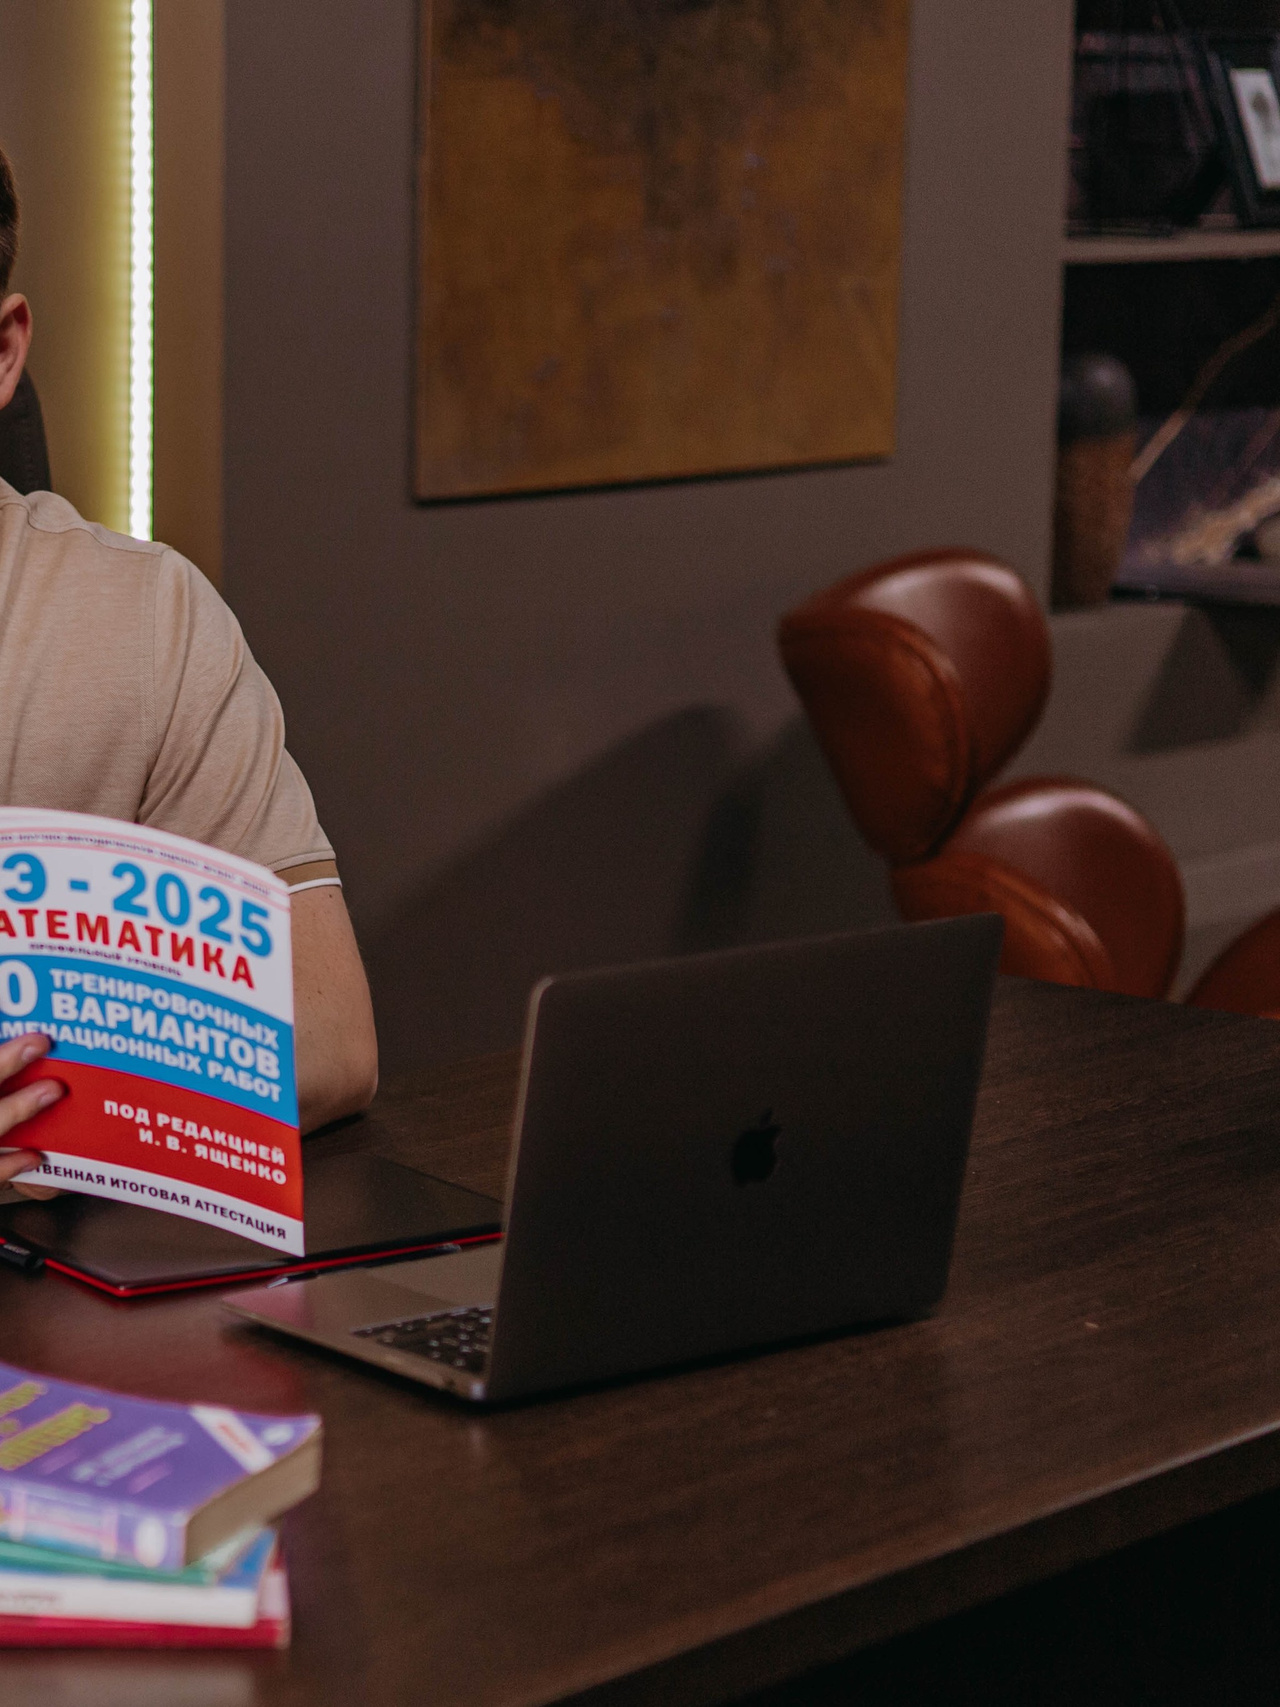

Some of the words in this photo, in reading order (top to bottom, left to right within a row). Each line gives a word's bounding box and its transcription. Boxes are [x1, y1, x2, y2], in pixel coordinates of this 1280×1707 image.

[69, 879, 89, 891] -
[112, 862, 273, 958] 2025
[50, 968, 279, 1050] ТРЕНИРОВОЧНЫХ
[51, 991, 280, 1080] ВАРИАНТОВ
[207, 1060, 282, 1103] РАБОТ
[104, 1099, 150, 1126] ПОД
[156, 1112, 286, 1166] РЕДАКЦИЕЙ
[139, 1128, 161, 1147] И.
[166, 1135, 187, 1154] В.
[194, 1143, 287, 1185] ЯЩЕНКО
[110, 1177, 190, 1206] ИТОГОВАЯ
[194, 1199, 287, 1240] АТТЕСТАЦИЯ
